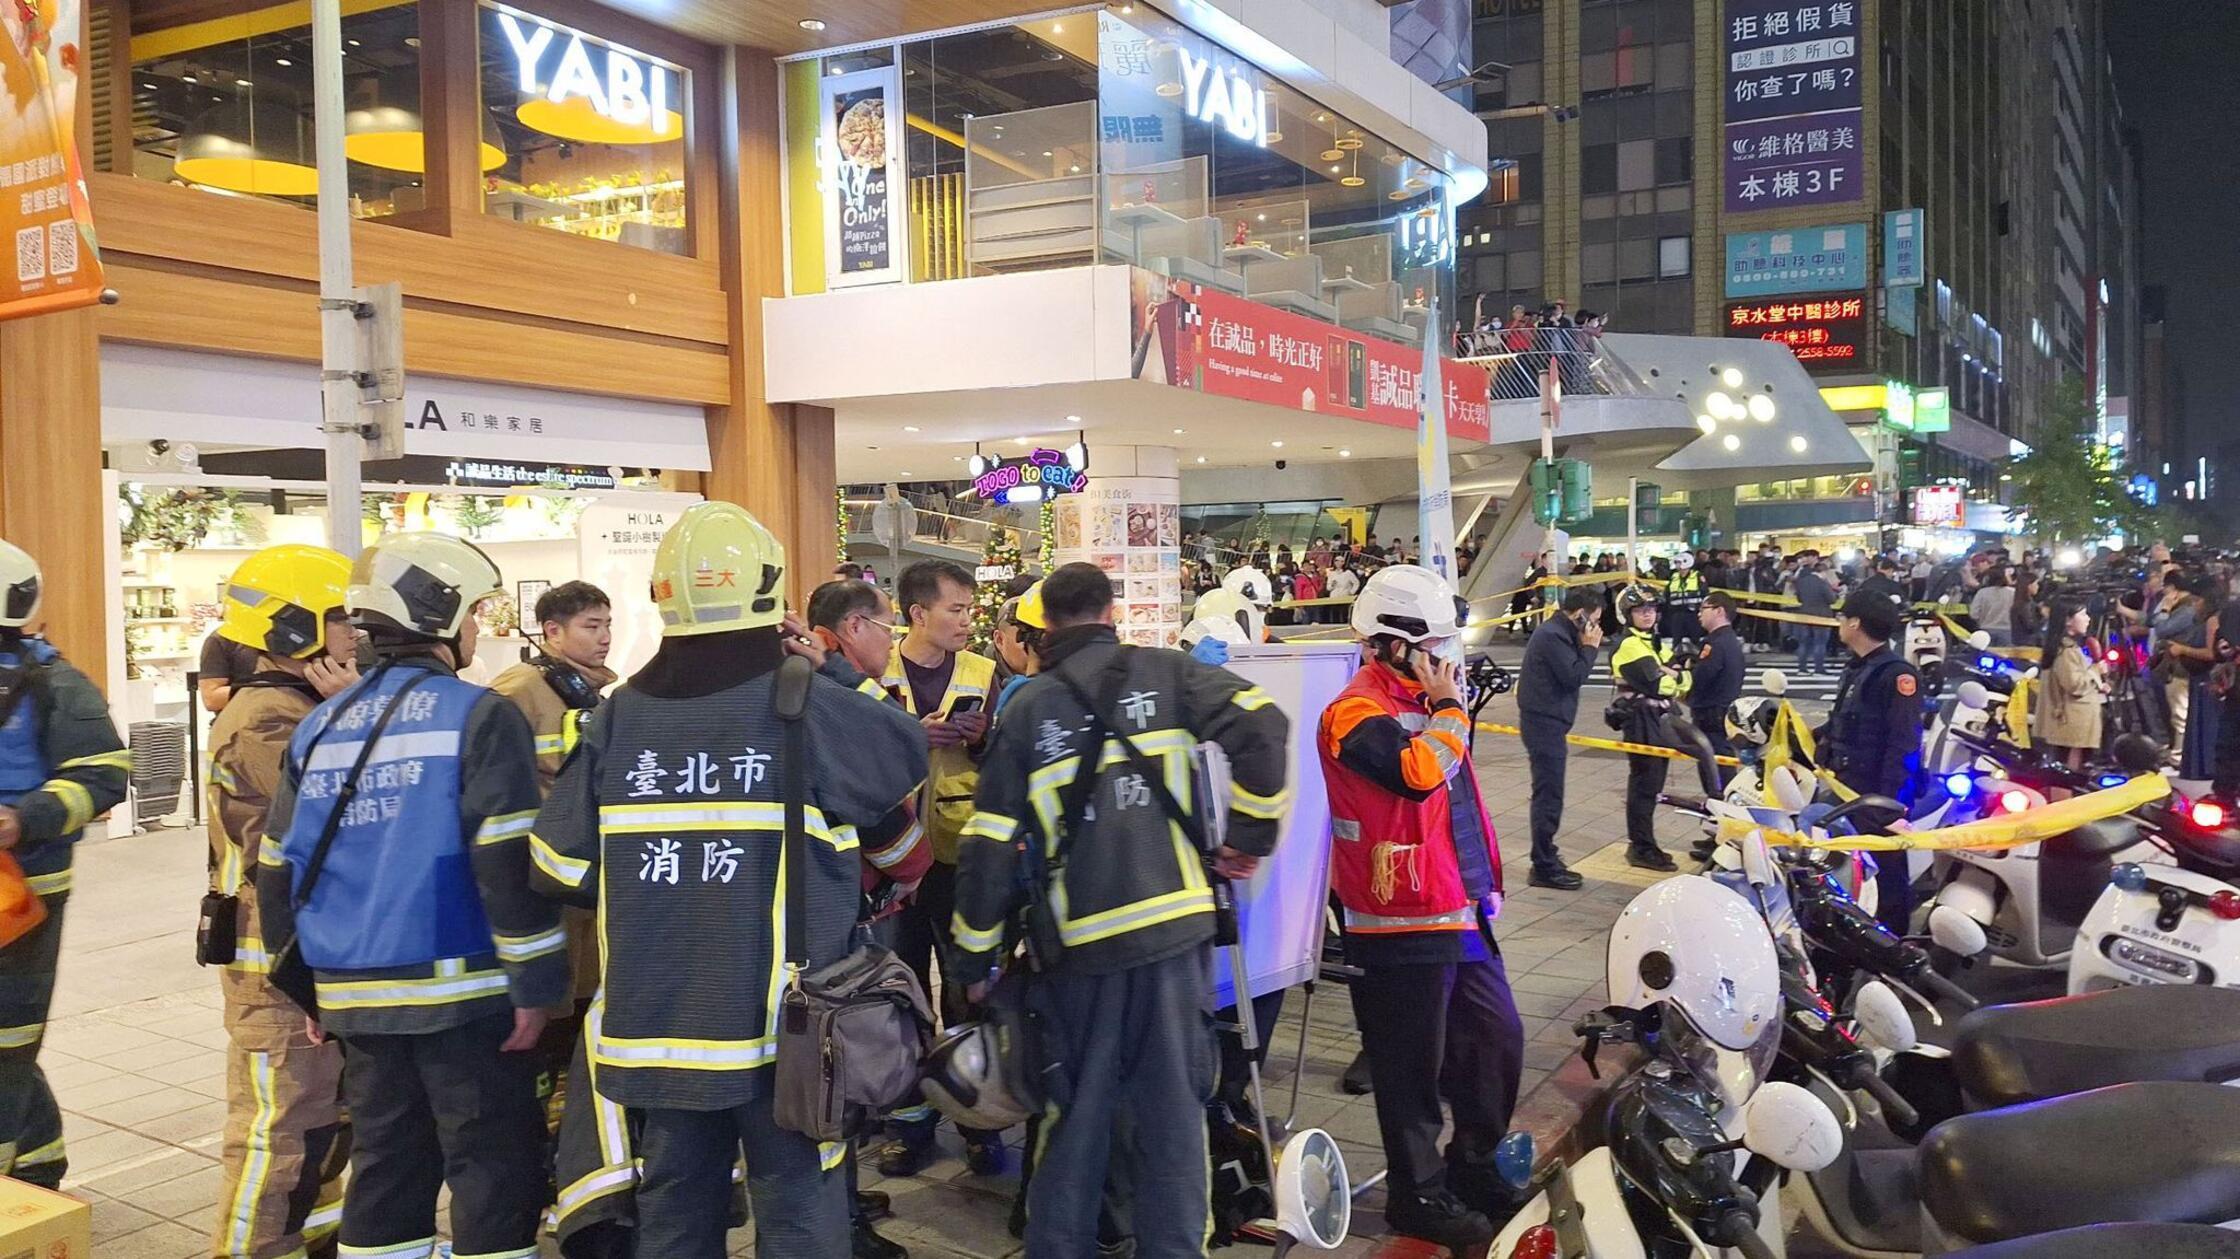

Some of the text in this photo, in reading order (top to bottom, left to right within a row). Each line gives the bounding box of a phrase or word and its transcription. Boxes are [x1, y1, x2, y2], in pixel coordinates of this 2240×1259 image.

[1732, 2, 1854, 41] 拒絕假貨
[498, 12, 669, 134] YABI
[1736, 43, 1822, 70] 認證診所
[1179, 46, 1267, 148] YABI
[1734, 67, 1855, 103] 你查了嗎？
[1758, 126, 1855, 159] 維格醫美
[1739, 167, 1845, 202] 本棟3F
[843, 198, 887, 227] Only!
[1731, 298, 1862, 326] 京水堂中醫診所
[1209, 317, 1323, 372] 在誠品，時光正好
[1380, 363, 1459, 419] 誠品聯卡
[460, 411, 544, 434] 和樂家居
[1021, 463, 1040, 484] to
[1041, 464, 1089, 494] eat!
[627, 513, 664, 525] HOLA
[695, 568, 736, 588] 三大
[1034, 691, 1161, 764] 臺市
[625, 746, 773, 798] 臺北市
[638, 837, 745, 885] 消防
